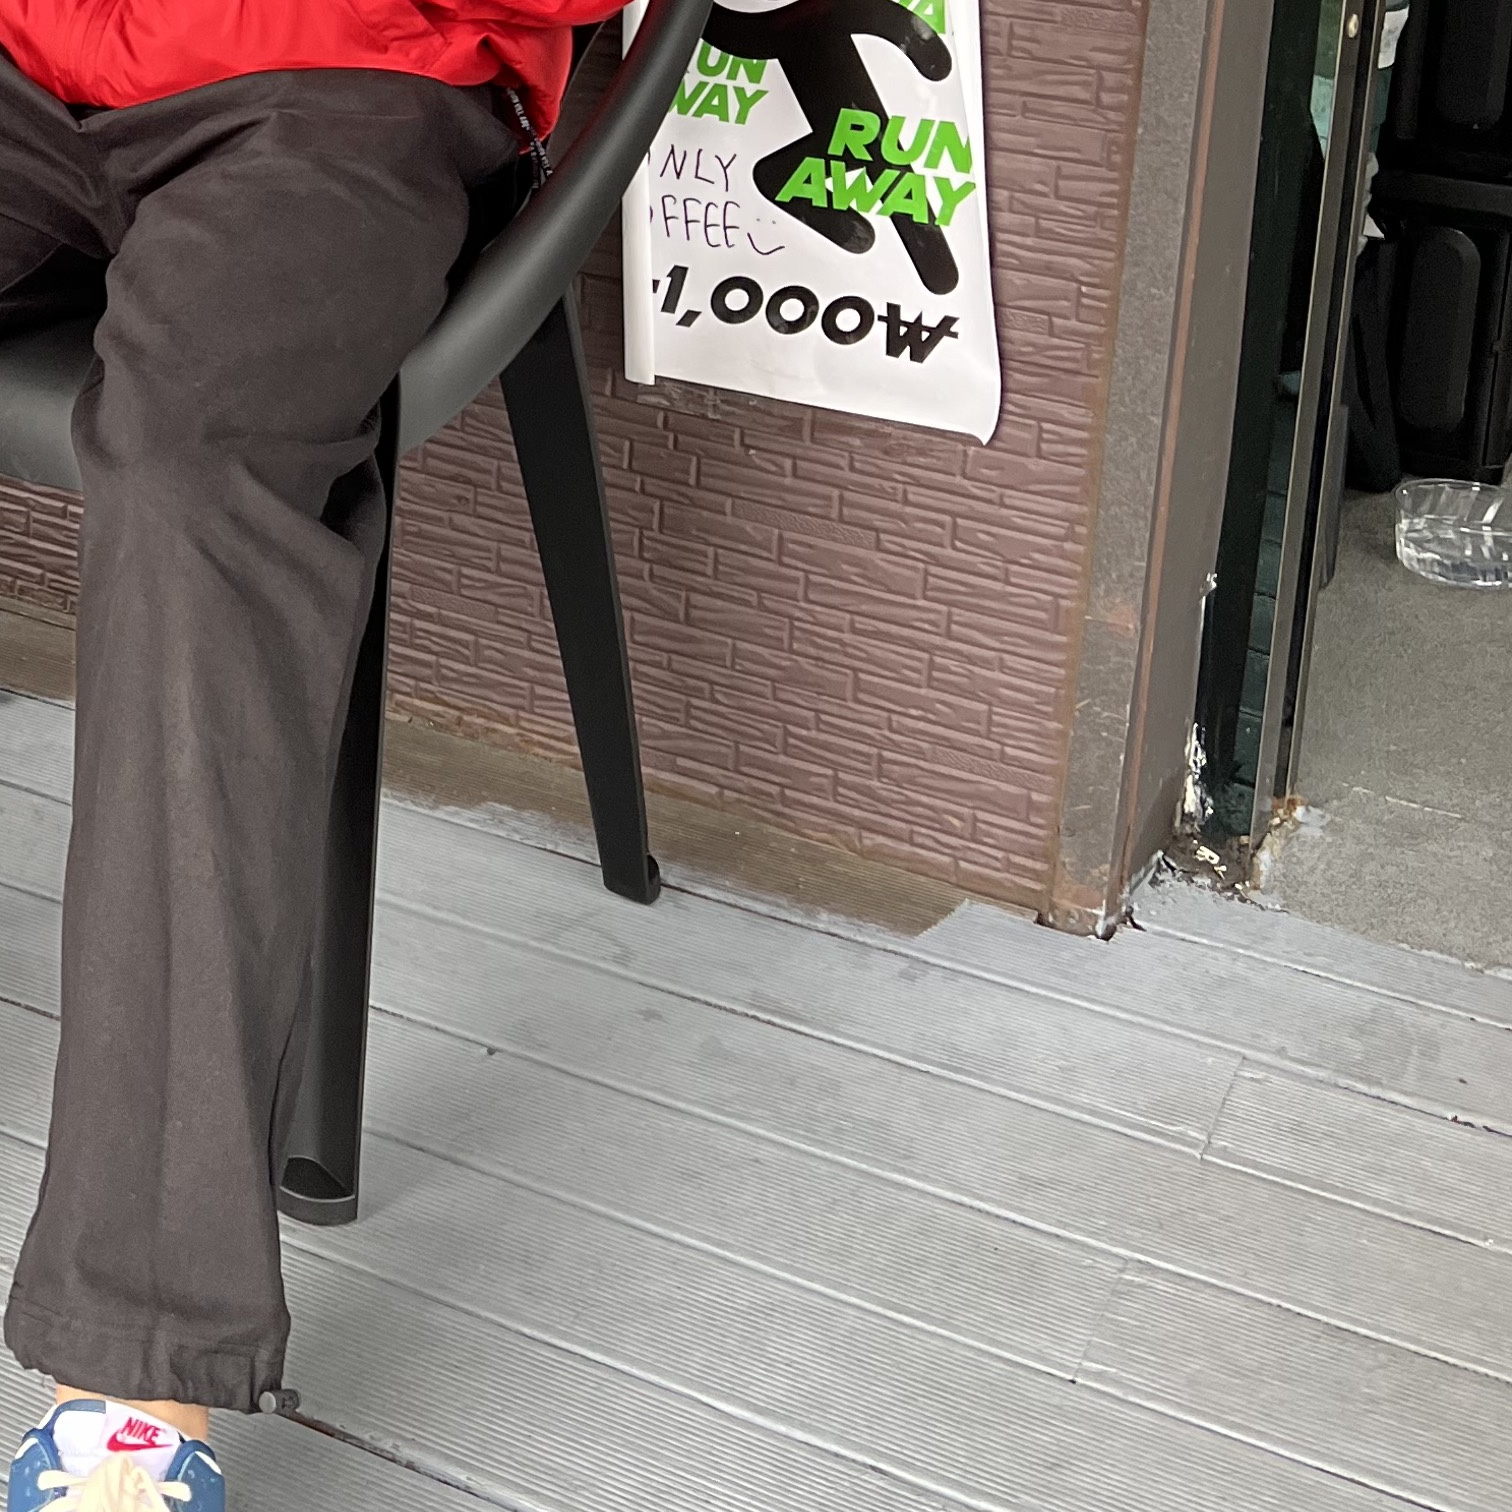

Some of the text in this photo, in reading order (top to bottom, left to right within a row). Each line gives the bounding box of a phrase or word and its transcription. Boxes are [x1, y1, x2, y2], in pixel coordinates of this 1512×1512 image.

[827, 108, 973, 174] RUN
[648, 144, 737, 192] NLY
[775, 157, 976, 226] AWAY
[650, 195, 741, 248] FFEE
[120, 1416, 162, 1445] NIKE
